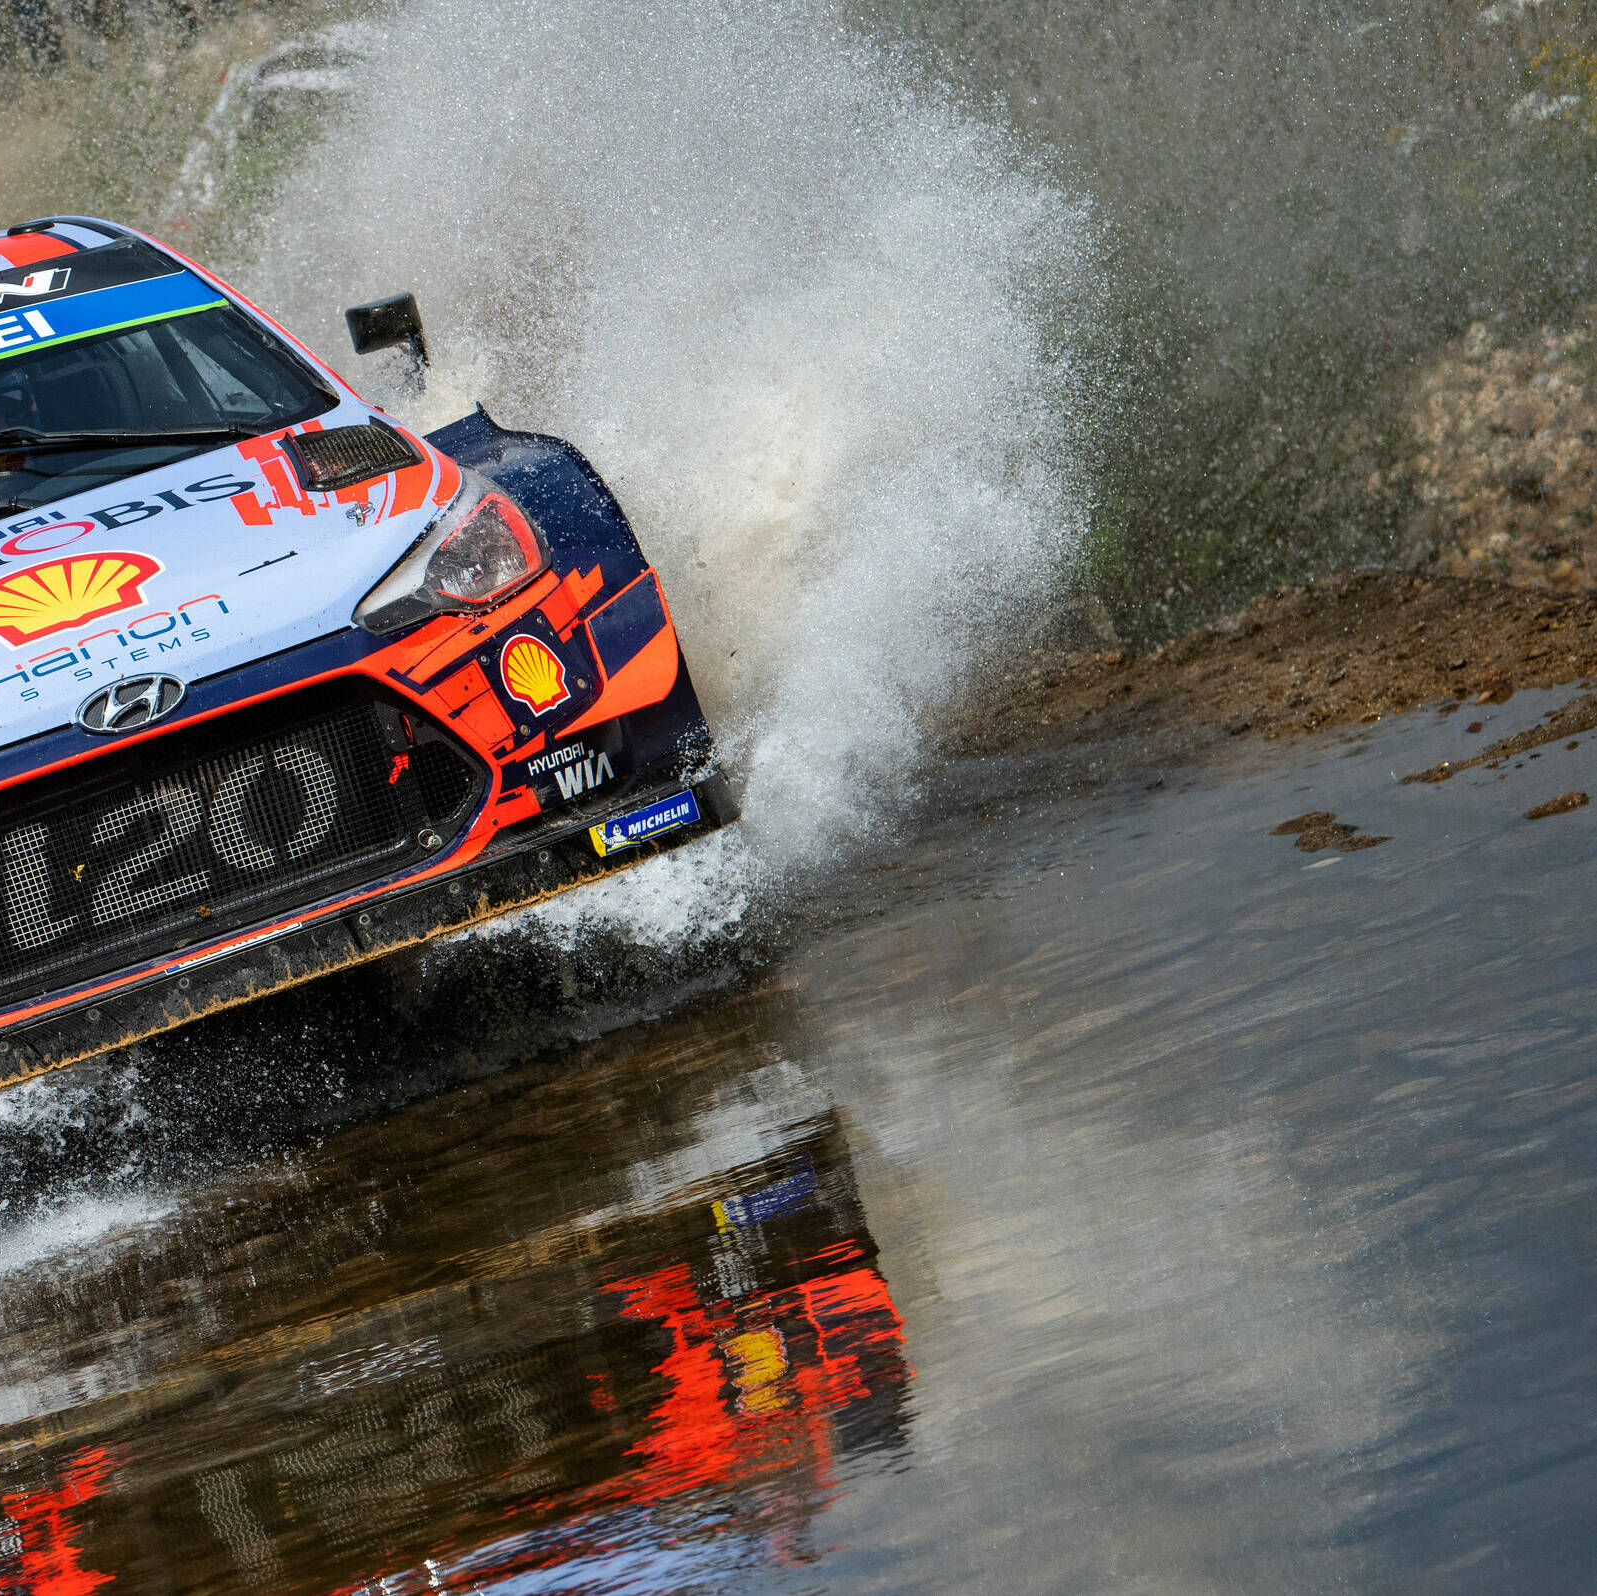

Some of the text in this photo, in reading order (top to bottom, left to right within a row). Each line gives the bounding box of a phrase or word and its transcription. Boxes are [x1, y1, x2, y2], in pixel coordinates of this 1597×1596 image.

[528, 742, 584, 776] HYUNDAI
[554, 750, 615, 800] WIA
[628, 803, 690, 836] MICHELIN
